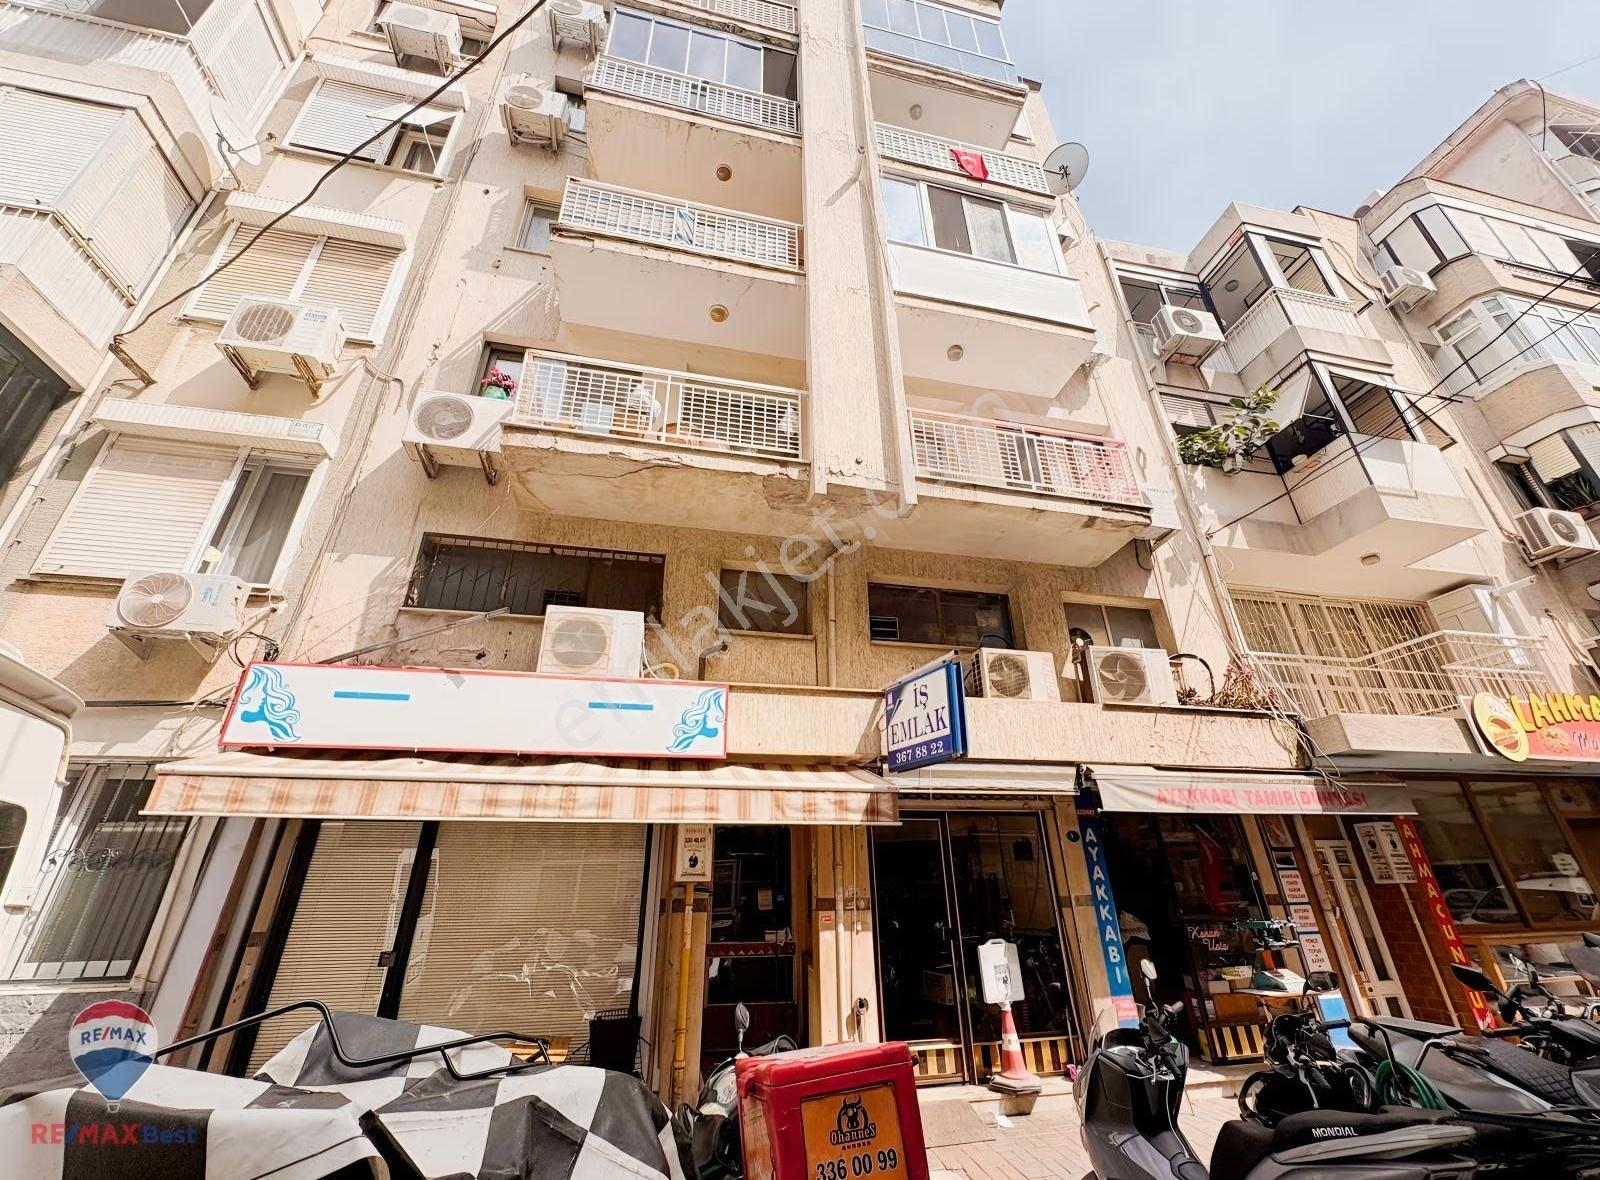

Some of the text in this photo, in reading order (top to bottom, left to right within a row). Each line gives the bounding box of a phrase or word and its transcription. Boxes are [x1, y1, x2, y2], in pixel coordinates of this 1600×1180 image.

[913, 683, 929, 710] İŞ
[890, 705, 948, 745] EMLAK
[895, 740, 944, 764] 367 88 22
[1085, 827, 1122, 984] AYAKKABI
[1312, 1126, 1358, 1138] MONDIAL
[816, 1148, 898, 1180] 336 00 99
